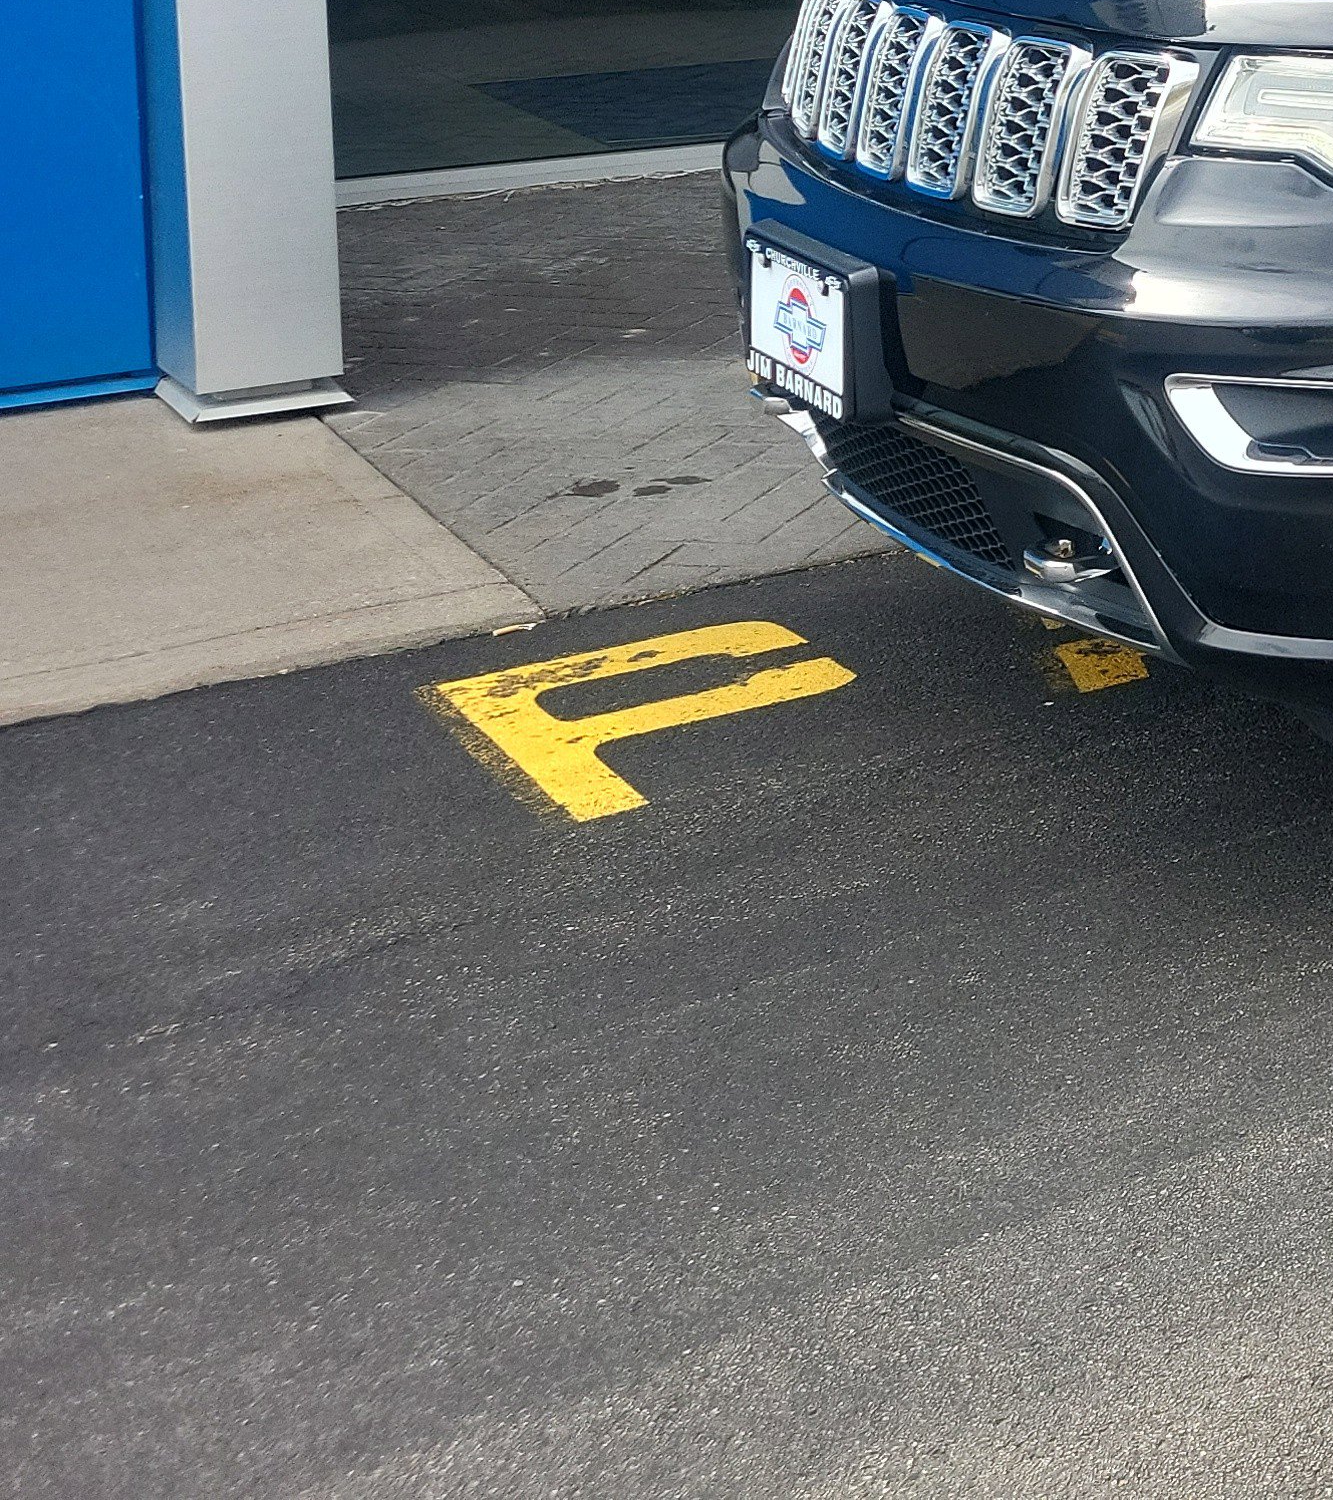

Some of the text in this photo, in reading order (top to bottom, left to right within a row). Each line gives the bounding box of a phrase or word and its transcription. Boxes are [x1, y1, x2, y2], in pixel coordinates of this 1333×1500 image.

[765, 247, 822, 282] CHURCHVILLE
[746, 349, 772, 380] JIM
[774, 363, 843, 420] BARNARD
